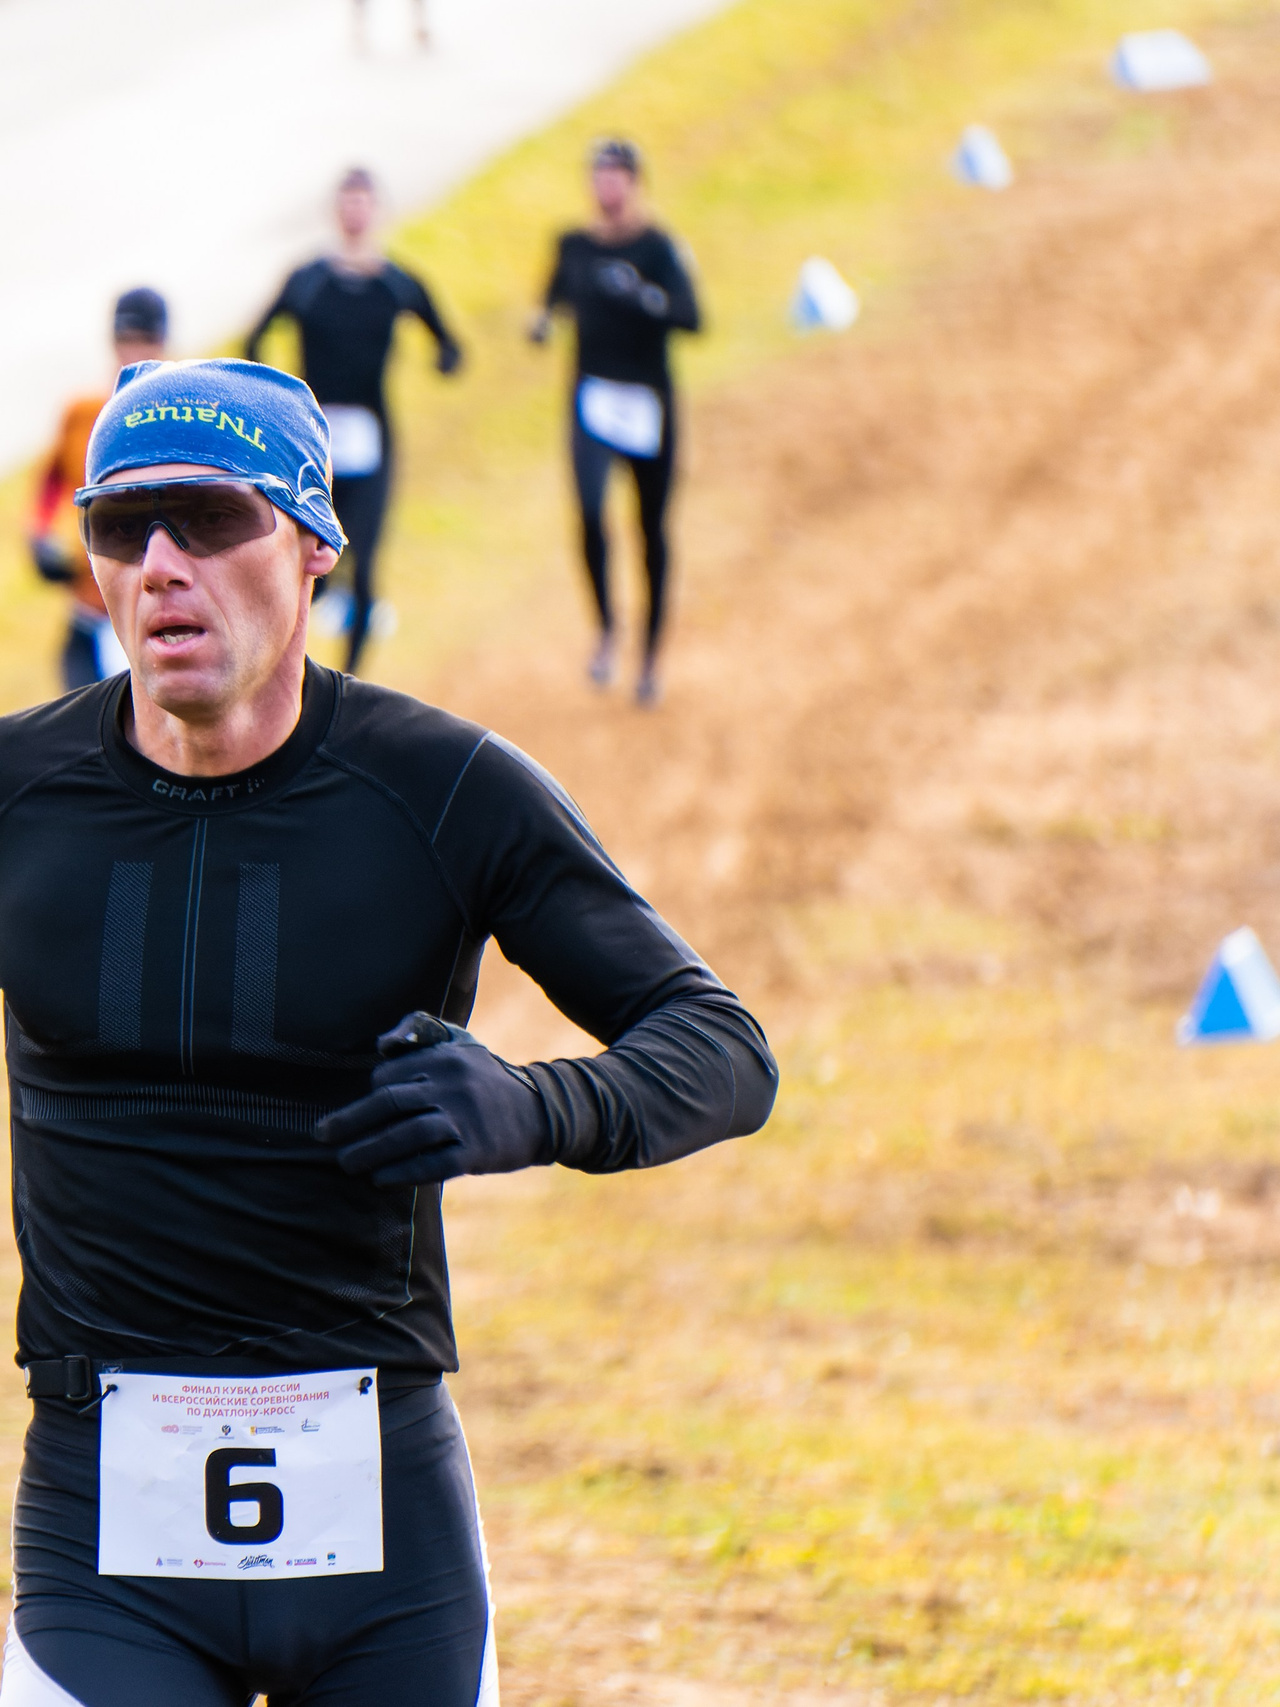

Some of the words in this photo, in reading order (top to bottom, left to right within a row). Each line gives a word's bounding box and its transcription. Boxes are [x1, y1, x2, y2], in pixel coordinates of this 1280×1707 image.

[124, 406, 266, 452] TNatura
[152, 779, 240, 801] CRAFT
[181, 1385, 220, 1395] ФИНАЛ
[223, 1386, 258, 1395] КУБКА
[261, 1383, 301, 1394] РОССИИ
[152, 1394, 159, 1403] И
[161, 1395, 248, 1406] ВСЕРОССИЙСКИЕ
[250, 1391, 330, 1406] СОРЕВНОВАНИЯ
[187, 1407, 201, 1416] ПО
[203, 1406, 296, 1418] ДУАТЛОНУ-КРОСС
[205, 1447, 284, 1546] 6
